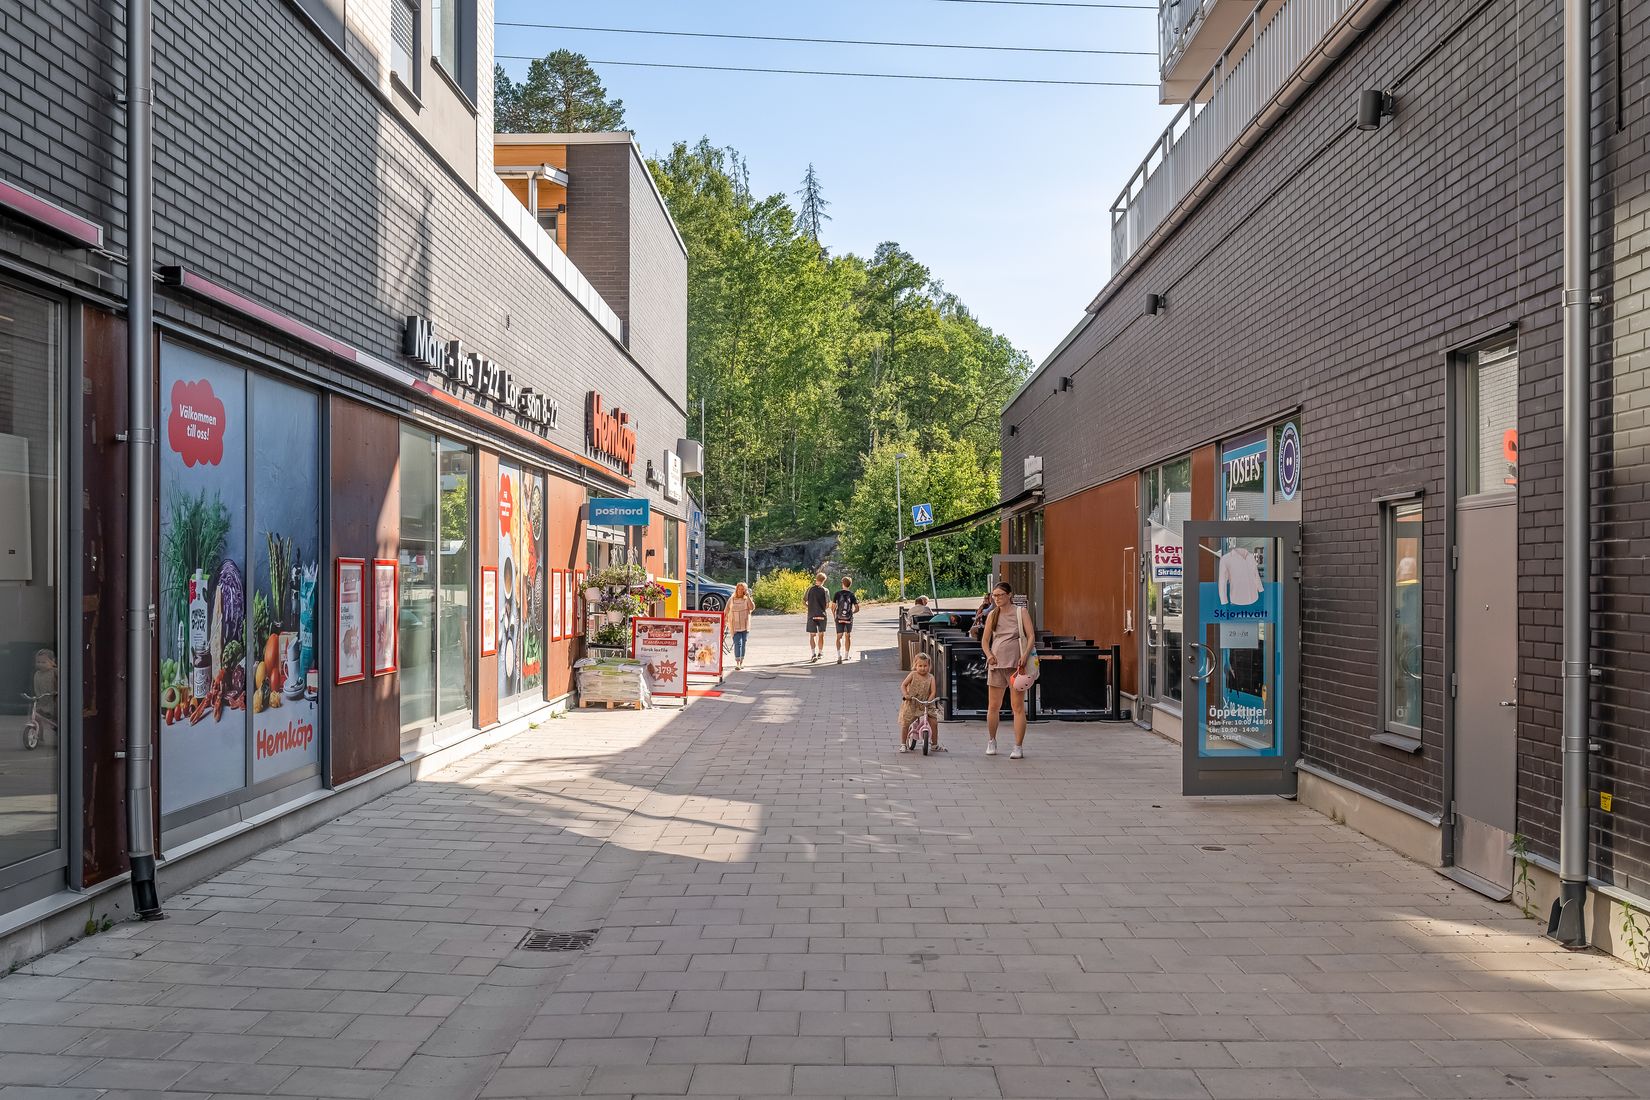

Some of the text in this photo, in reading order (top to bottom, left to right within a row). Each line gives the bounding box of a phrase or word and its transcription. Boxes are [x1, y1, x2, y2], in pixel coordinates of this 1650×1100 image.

[413, 315, 446, 372] Mån
[457, 340, 474, 386] fre
[476, 353, 500, 400] 7-22
[542, 394, 559, 429] 8-22
[179, 404, 217, 425] Välkommen
[187, 424, 210, 441] till oss!
[593, 390, 637, 477] Hemköp
[1228, 453, 1261, 493] JOSEFS
[595, 507, 643, 517] postnord
[1214, 609, 1268, 620] Skjorttvätt
[1209, 706, 1267, 719] Öppettider
[256, 718, 313, 761] Hemköp
